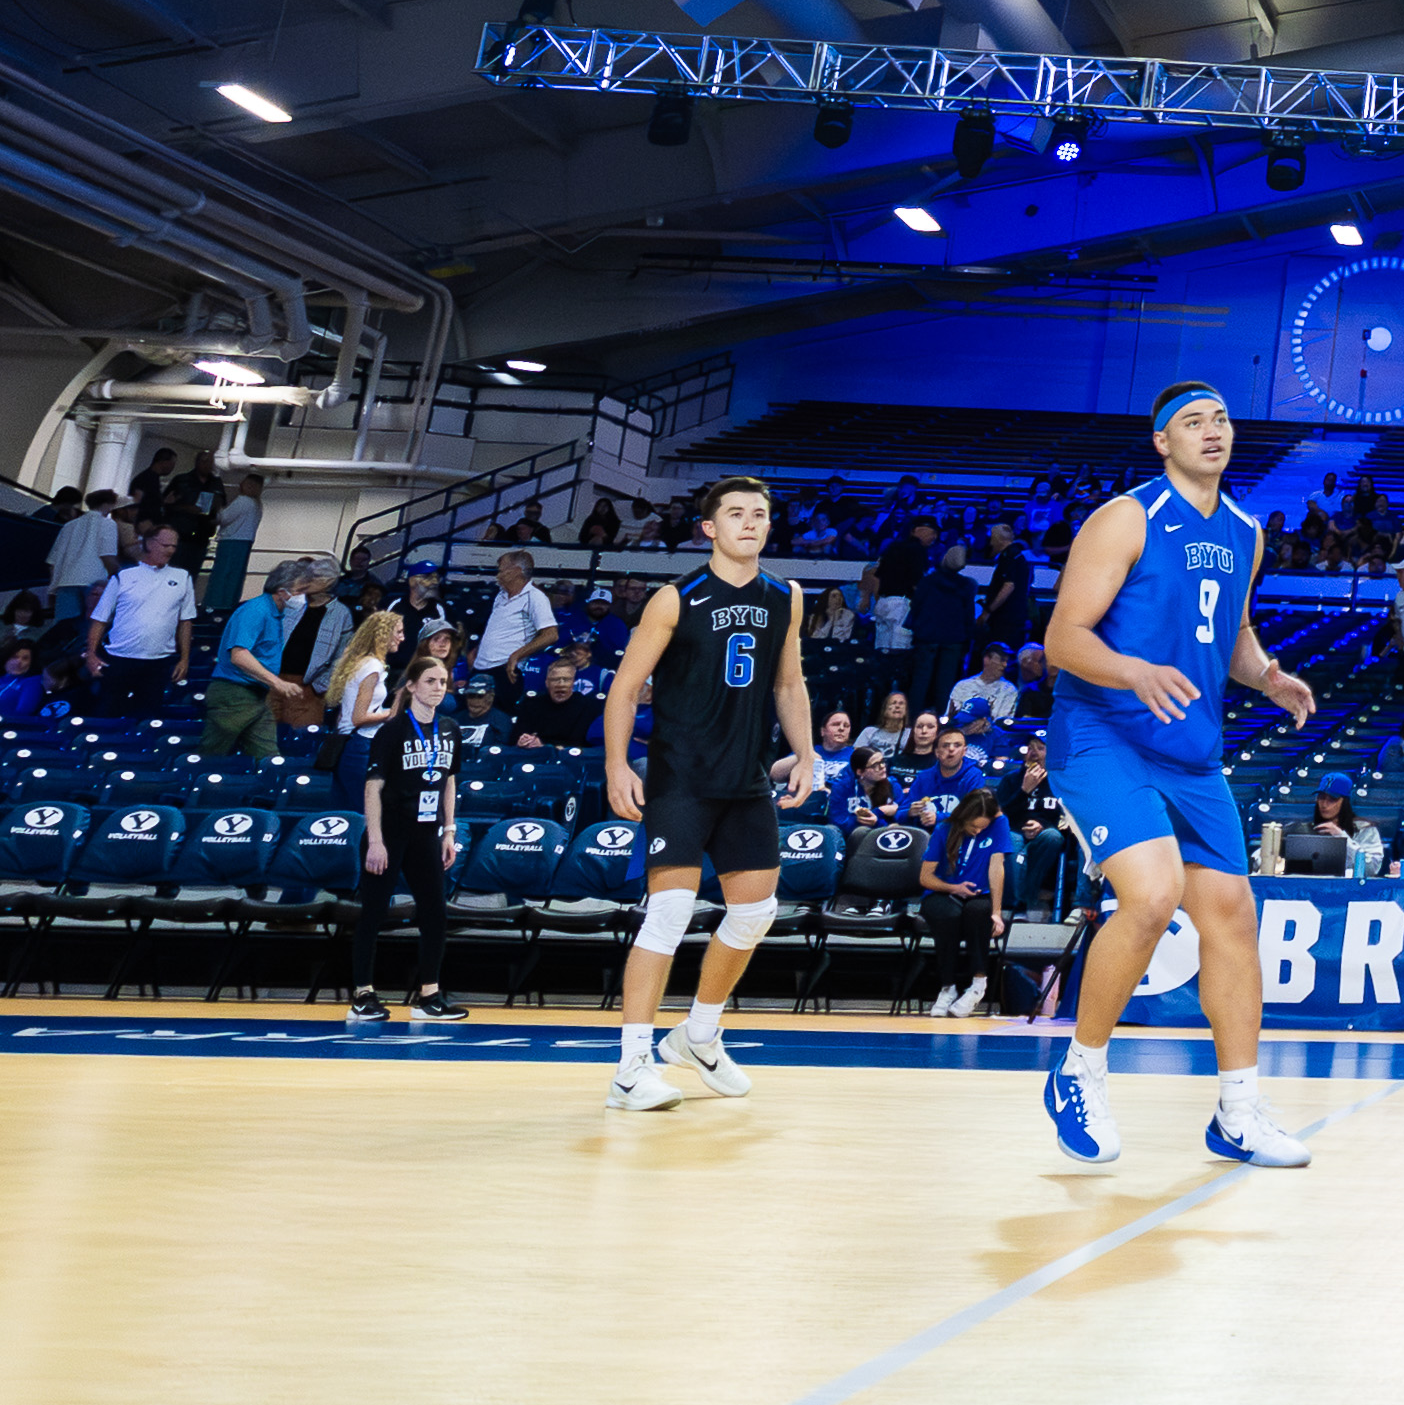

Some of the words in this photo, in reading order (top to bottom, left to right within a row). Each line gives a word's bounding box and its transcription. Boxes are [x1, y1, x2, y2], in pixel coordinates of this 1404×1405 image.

[1184, 542, 1234, 574] BYU
[711, 605, 769, 631] BYU
[1195, 578, 1221, 644] 9
[725, 632, 756, 688] 6
